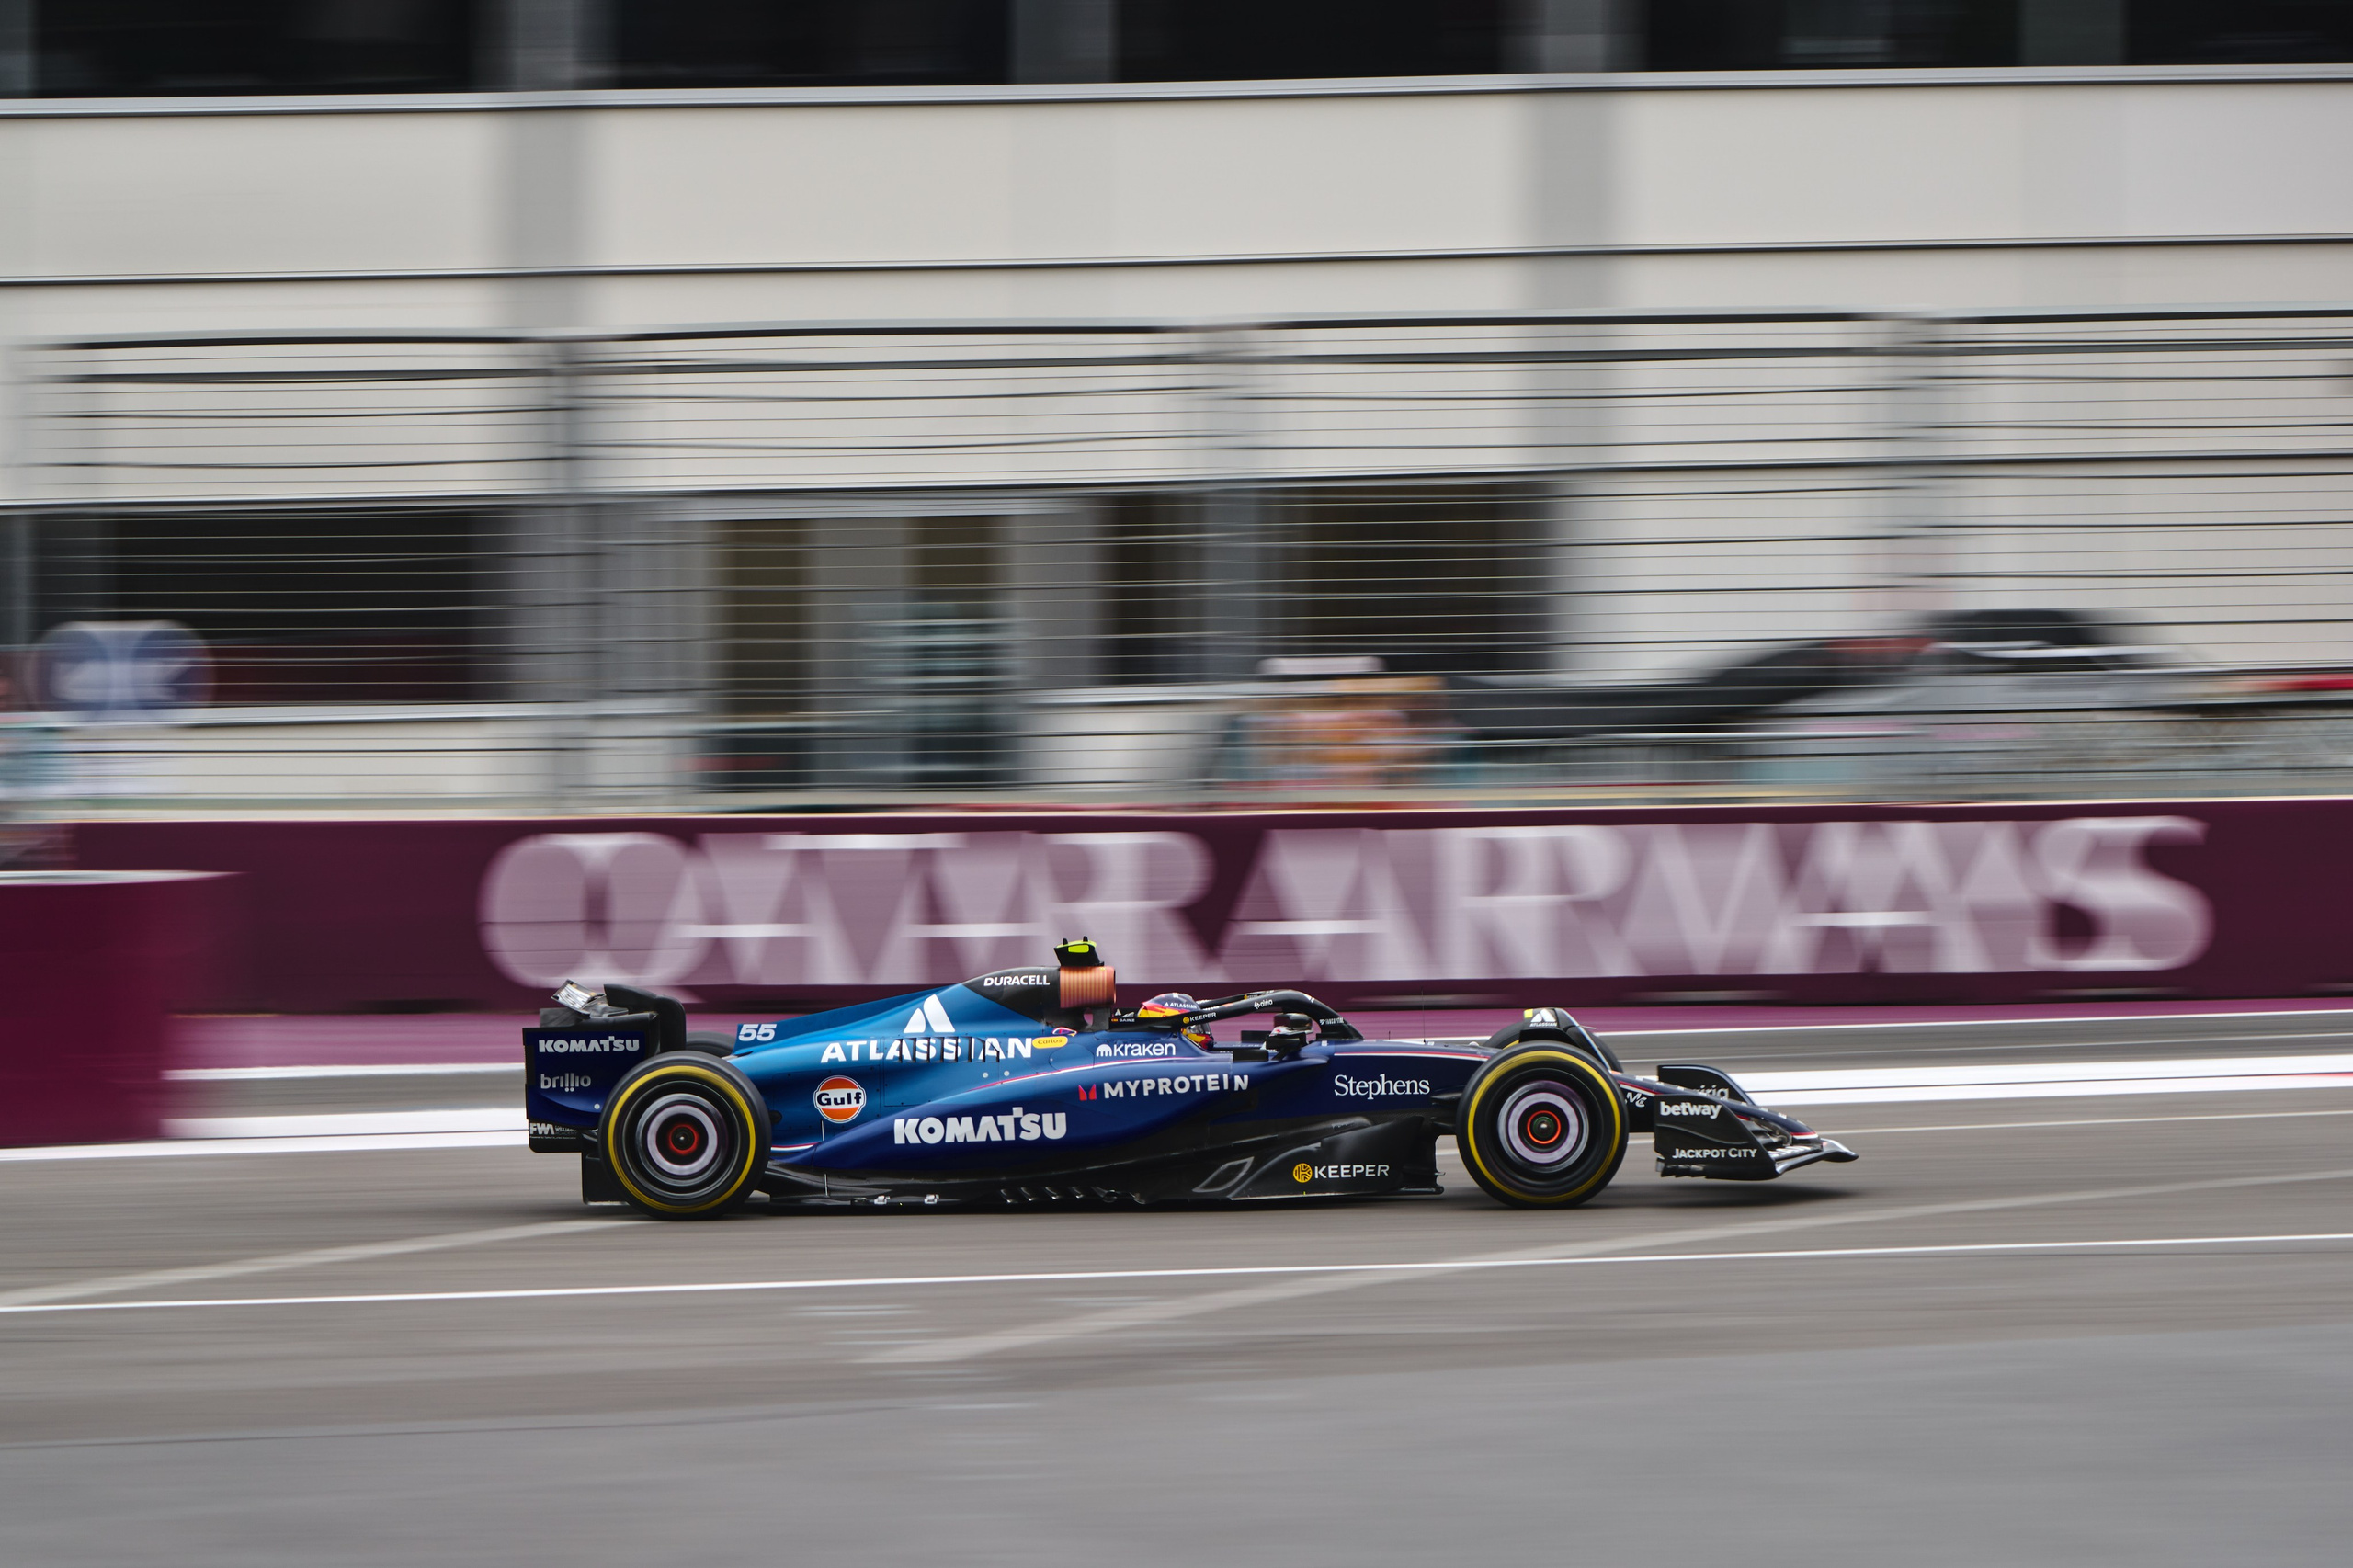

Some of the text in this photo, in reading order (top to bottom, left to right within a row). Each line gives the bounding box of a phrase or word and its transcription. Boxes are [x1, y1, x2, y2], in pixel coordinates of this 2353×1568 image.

[983, 974, 1050, 986] DURACELL
[1189, 1012, 1217, 1022] KEEPER
[738, 1024, 777, 1041] 55
[539, 1035, 640, 1053] KOMATSU
[820, 1037, 1032, 1063] ATLASSIAN
[1113, 1042, 1176, 1057] kraken
[1104, 1074, 1248, 1098] MYPROTEIN
[1334, 1074, 1430, 1100] Stephens
[816, 1091, 862, 1107] Gulf
[1660, 1101, 1722, 1119] betway
[893, 1107, 1067, 1144] KOMATSU
[1672, 1148, 1757, 1159] JACKPOT CITY
[1314, 1165, 1390, 1179] KEEPER
